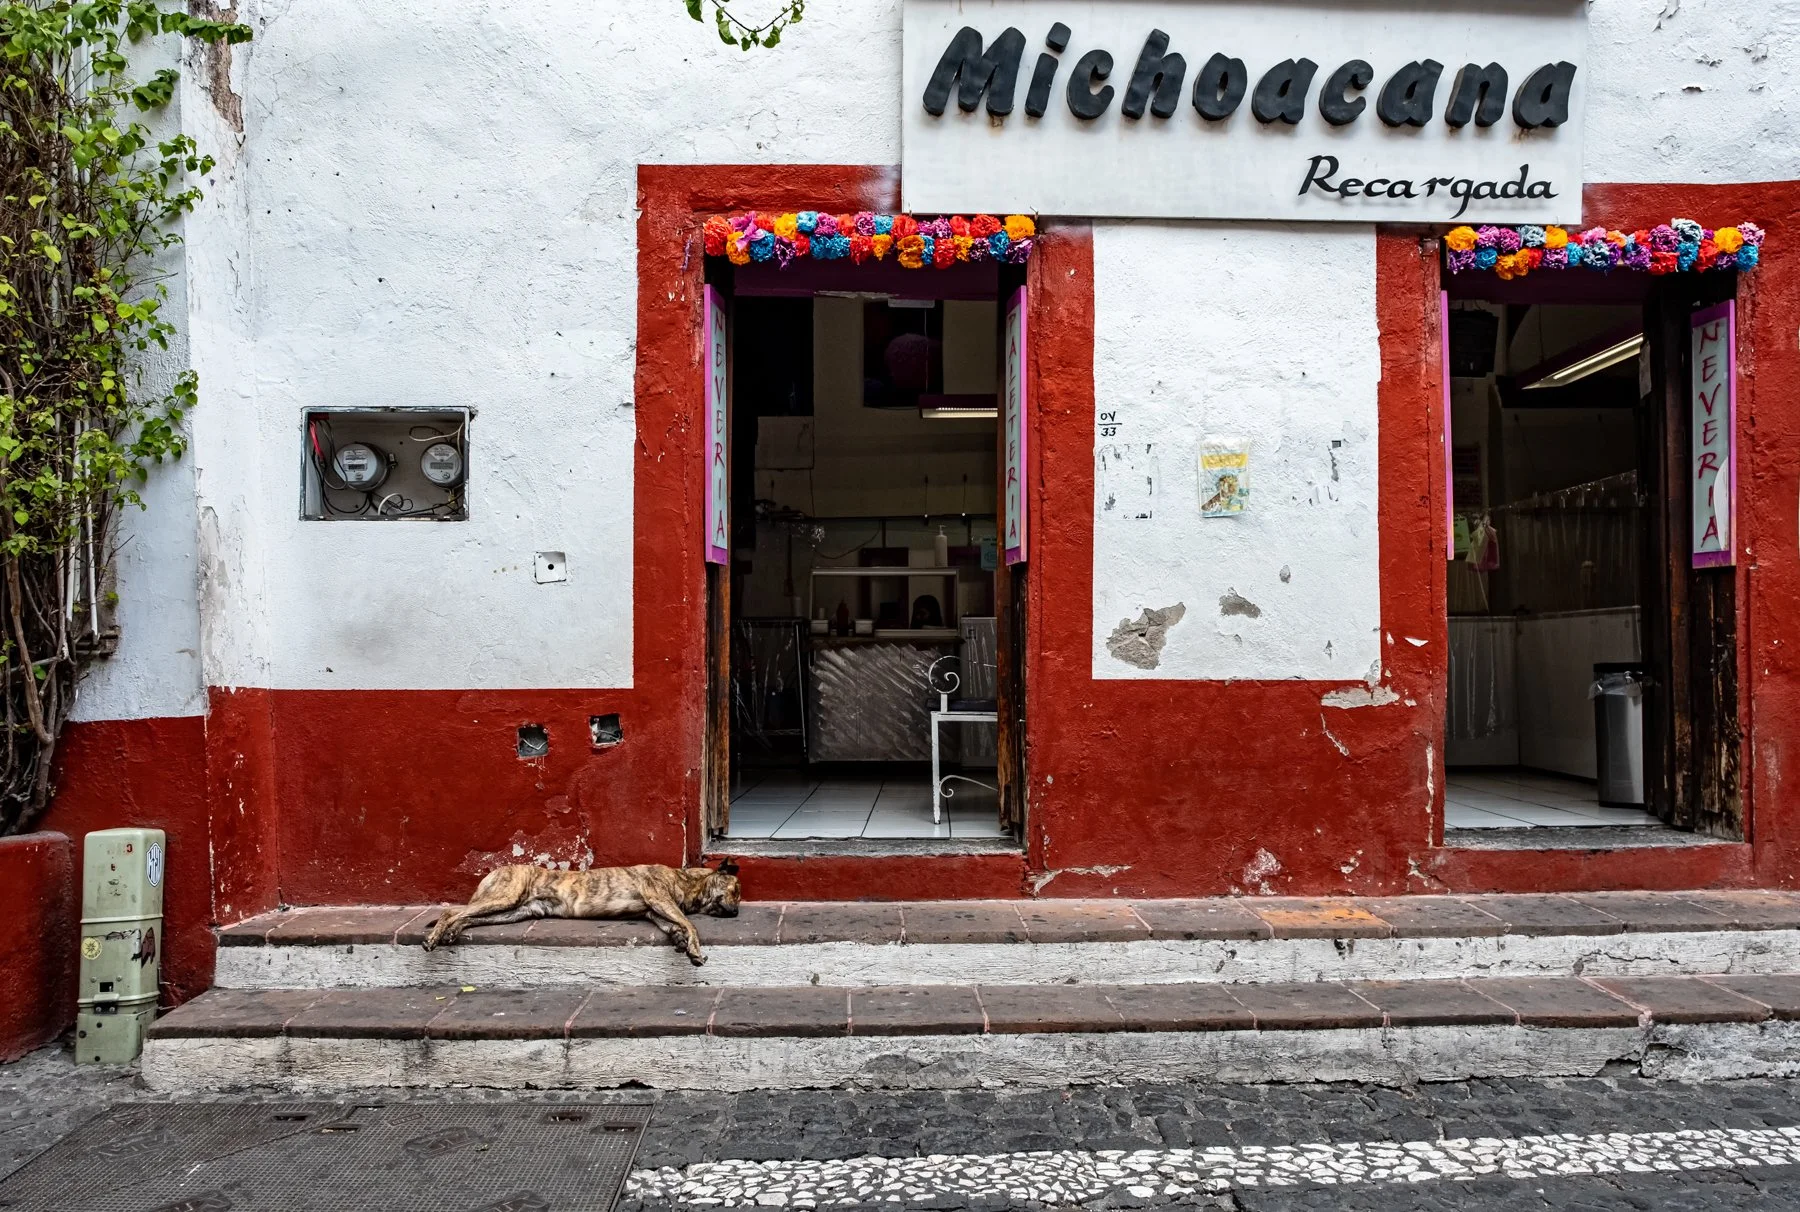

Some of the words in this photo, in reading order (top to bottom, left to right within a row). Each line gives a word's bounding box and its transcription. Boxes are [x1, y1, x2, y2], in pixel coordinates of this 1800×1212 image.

[922, 22, 1578, 129] Michoacana
[1297, 154, 1559, 220] Recargada
[714, 309, 725, 541] NEVERIA
[1007, 312, 1018, 539] PALETERIA
[1100, 427, 1116, 437] 33
[1698, 322, 1722, 549] NEVERIA
